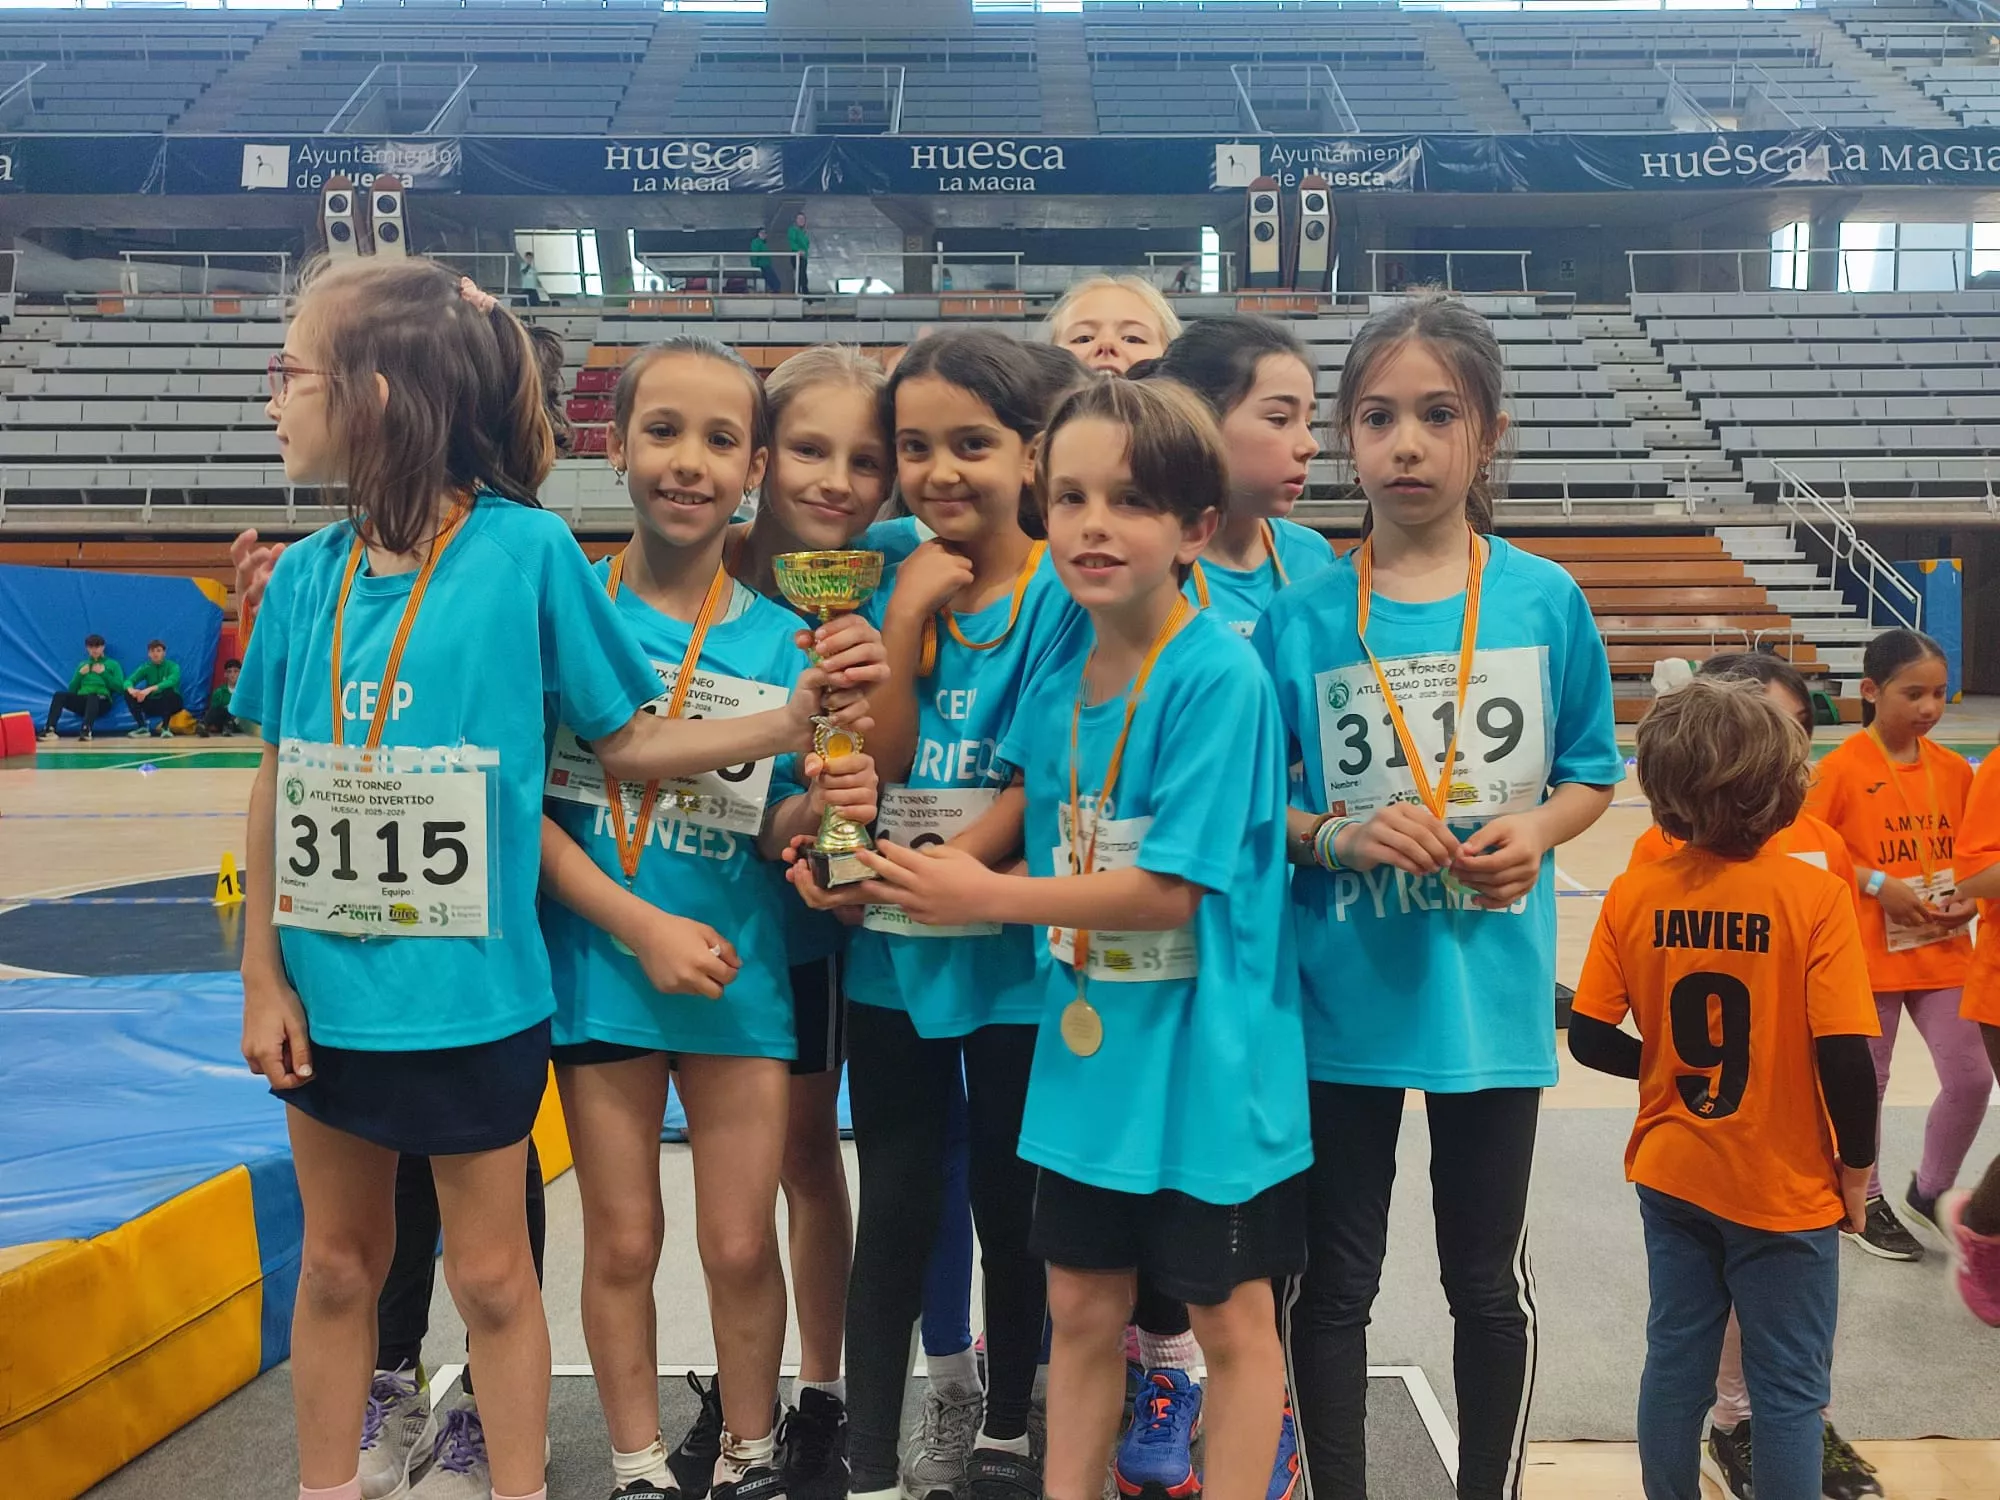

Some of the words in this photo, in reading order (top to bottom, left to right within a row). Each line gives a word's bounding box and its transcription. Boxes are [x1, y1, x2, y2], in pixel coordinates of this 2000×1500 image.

[297, 143, 451, 168] Ayuntamiento
[1270, 143, 1421, 168] Ayuntamiento
[297, 170, 322, 188] de
[1271, 170, 1296, 188] de
[672, 671, 715, 689] TNEO
[1385, 668, 1405, 678] XIX
[1411, 663, 1456, 675] TORNEO
[1356, 680, 1420, 696] ATLEISMO
[1424, 674, 1488, 688] DIVERDO
[342, 681, 413, 721] CEP
[1336, 697, 1524, 776] 3119
[1439, 767, 1471, 778] Euipo:
[333, 778, 352, 789] XIX
[356, 780, 402, 790] TORNEO
[309, 790, 365, 805] ATLETISMO
[369, 795, 435, 806] DIVERTIDO
[898, 795, 938, 805] TORNEO
[909, 808, 963, 818] DIVERTIDO
[288, 814, 469, 886] 3115
[221, 873, 233, 896] 1
[1653, 909, 1771, 954] JAVIER
[1669, 971, 1751, 1120] 9
